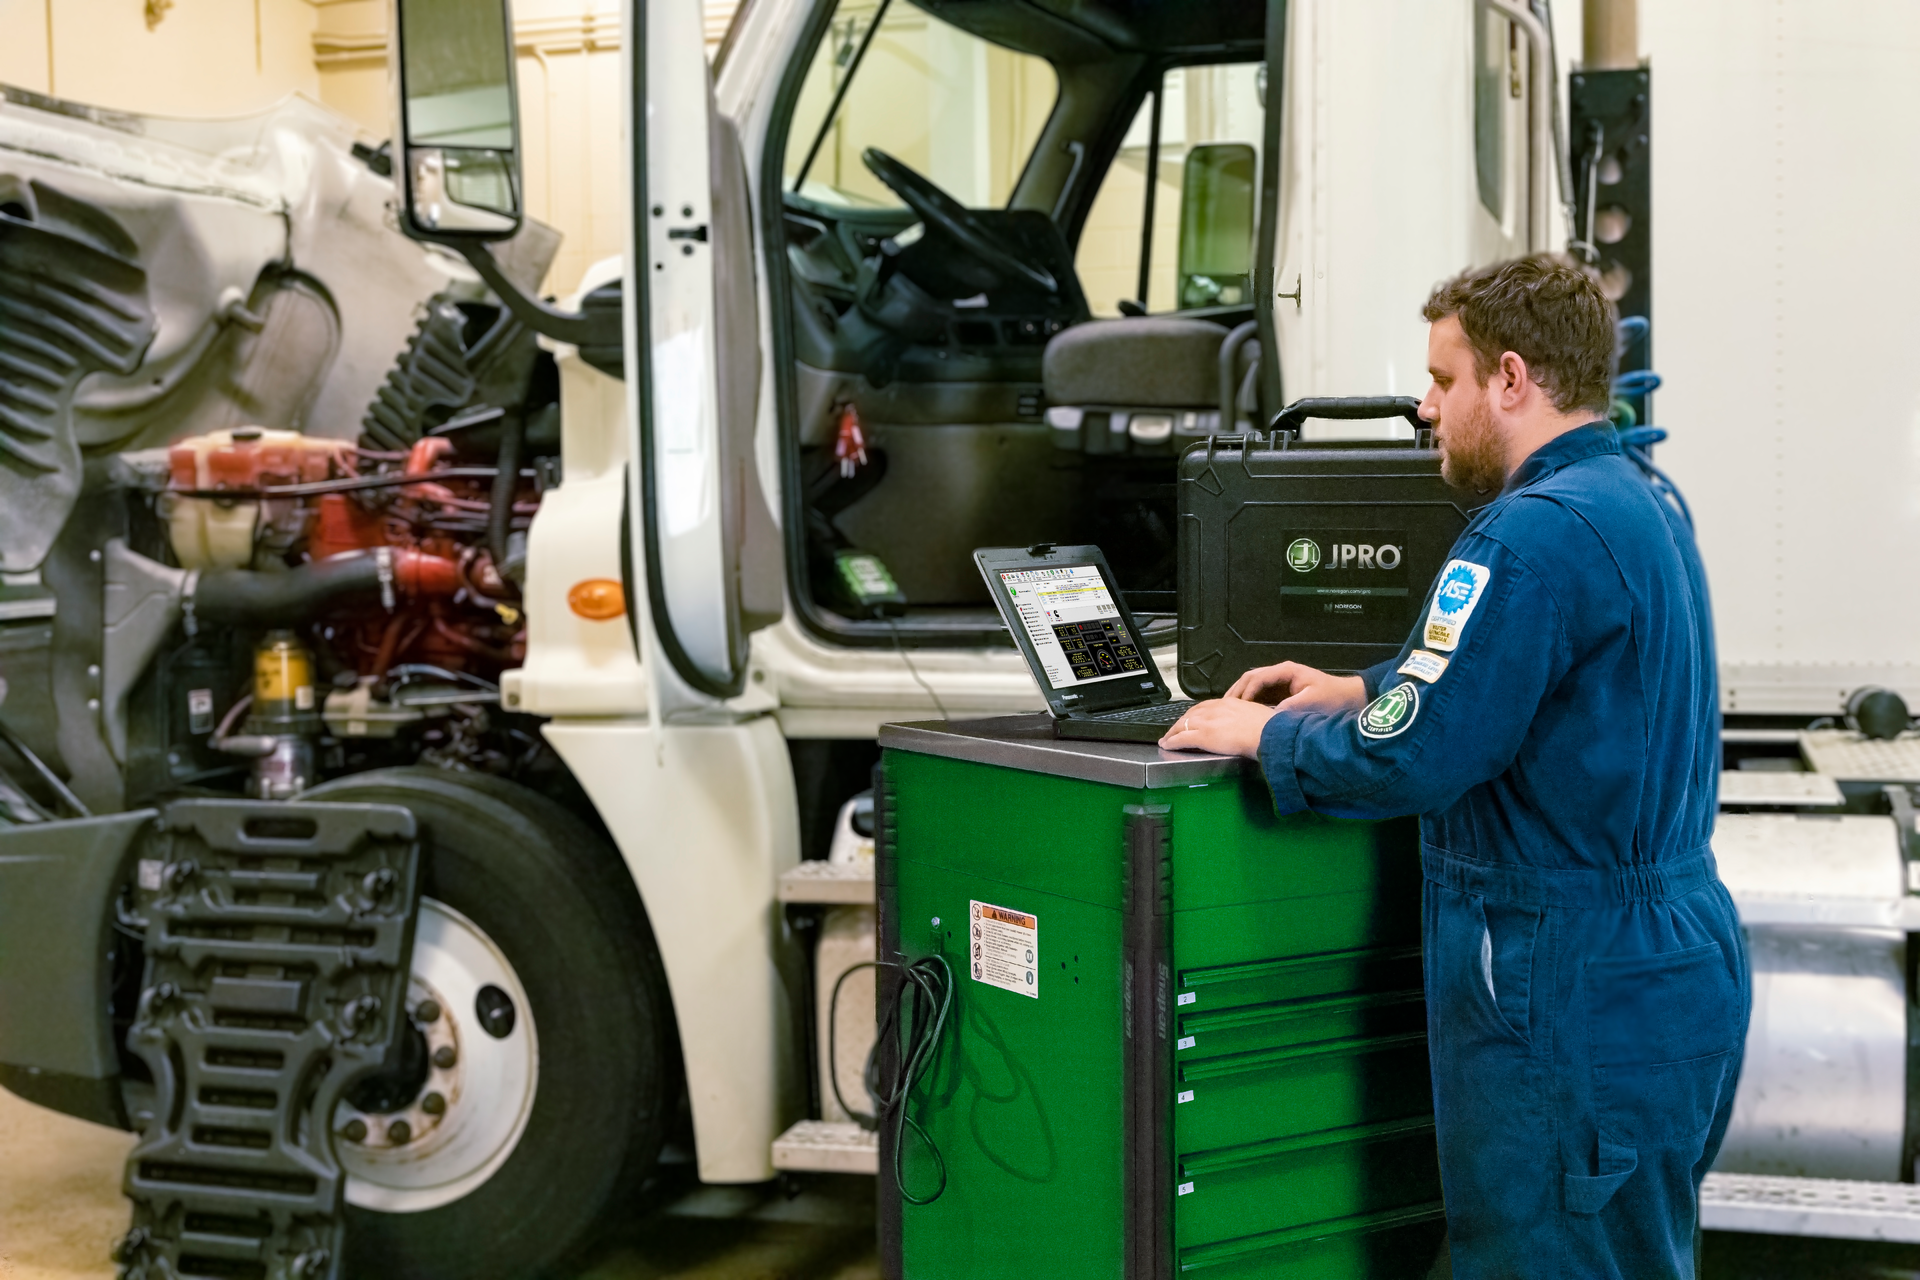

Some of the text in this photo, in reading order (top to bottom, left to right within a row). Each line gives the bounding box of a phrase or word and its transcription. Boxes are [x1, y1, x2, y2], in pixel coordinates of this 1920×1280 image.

[1324, 544, 1401, 569] JPRO
[1440, 579, 1472, 600] ASE
[998, 910, 1026, 926] WARNING
[1157, 962, 1169, 1040] Snap-on
